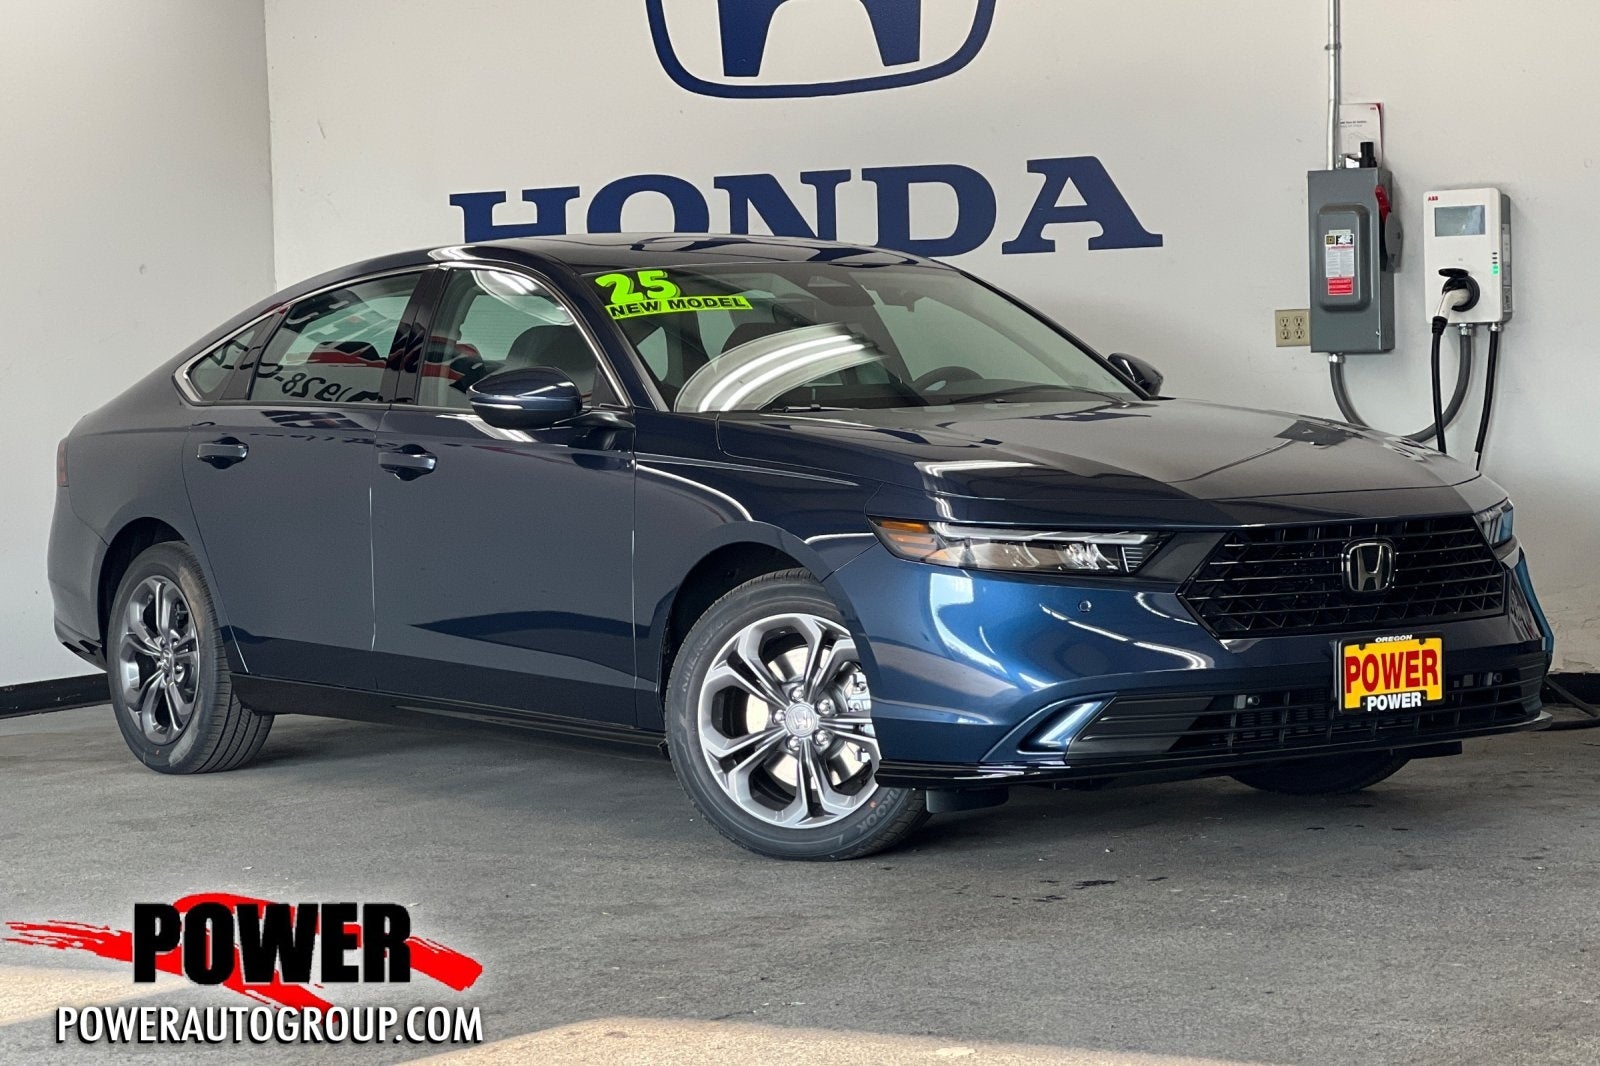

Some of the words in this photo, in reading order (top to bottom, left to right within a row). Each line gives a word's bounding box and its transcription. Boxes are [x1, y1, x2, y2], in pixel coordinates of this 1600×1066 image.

[450, 156, 1163, 257] HONDA
[595, 270, 681, 304] 25
[611, 301, 660, 317] NEW
[669, 297, 746, 310] MODEL
[1375, 634, 1413, 643] OREGON
[1345, 649, 1439, 694] POWER
[1367, 691, 1422, 712] POWER
